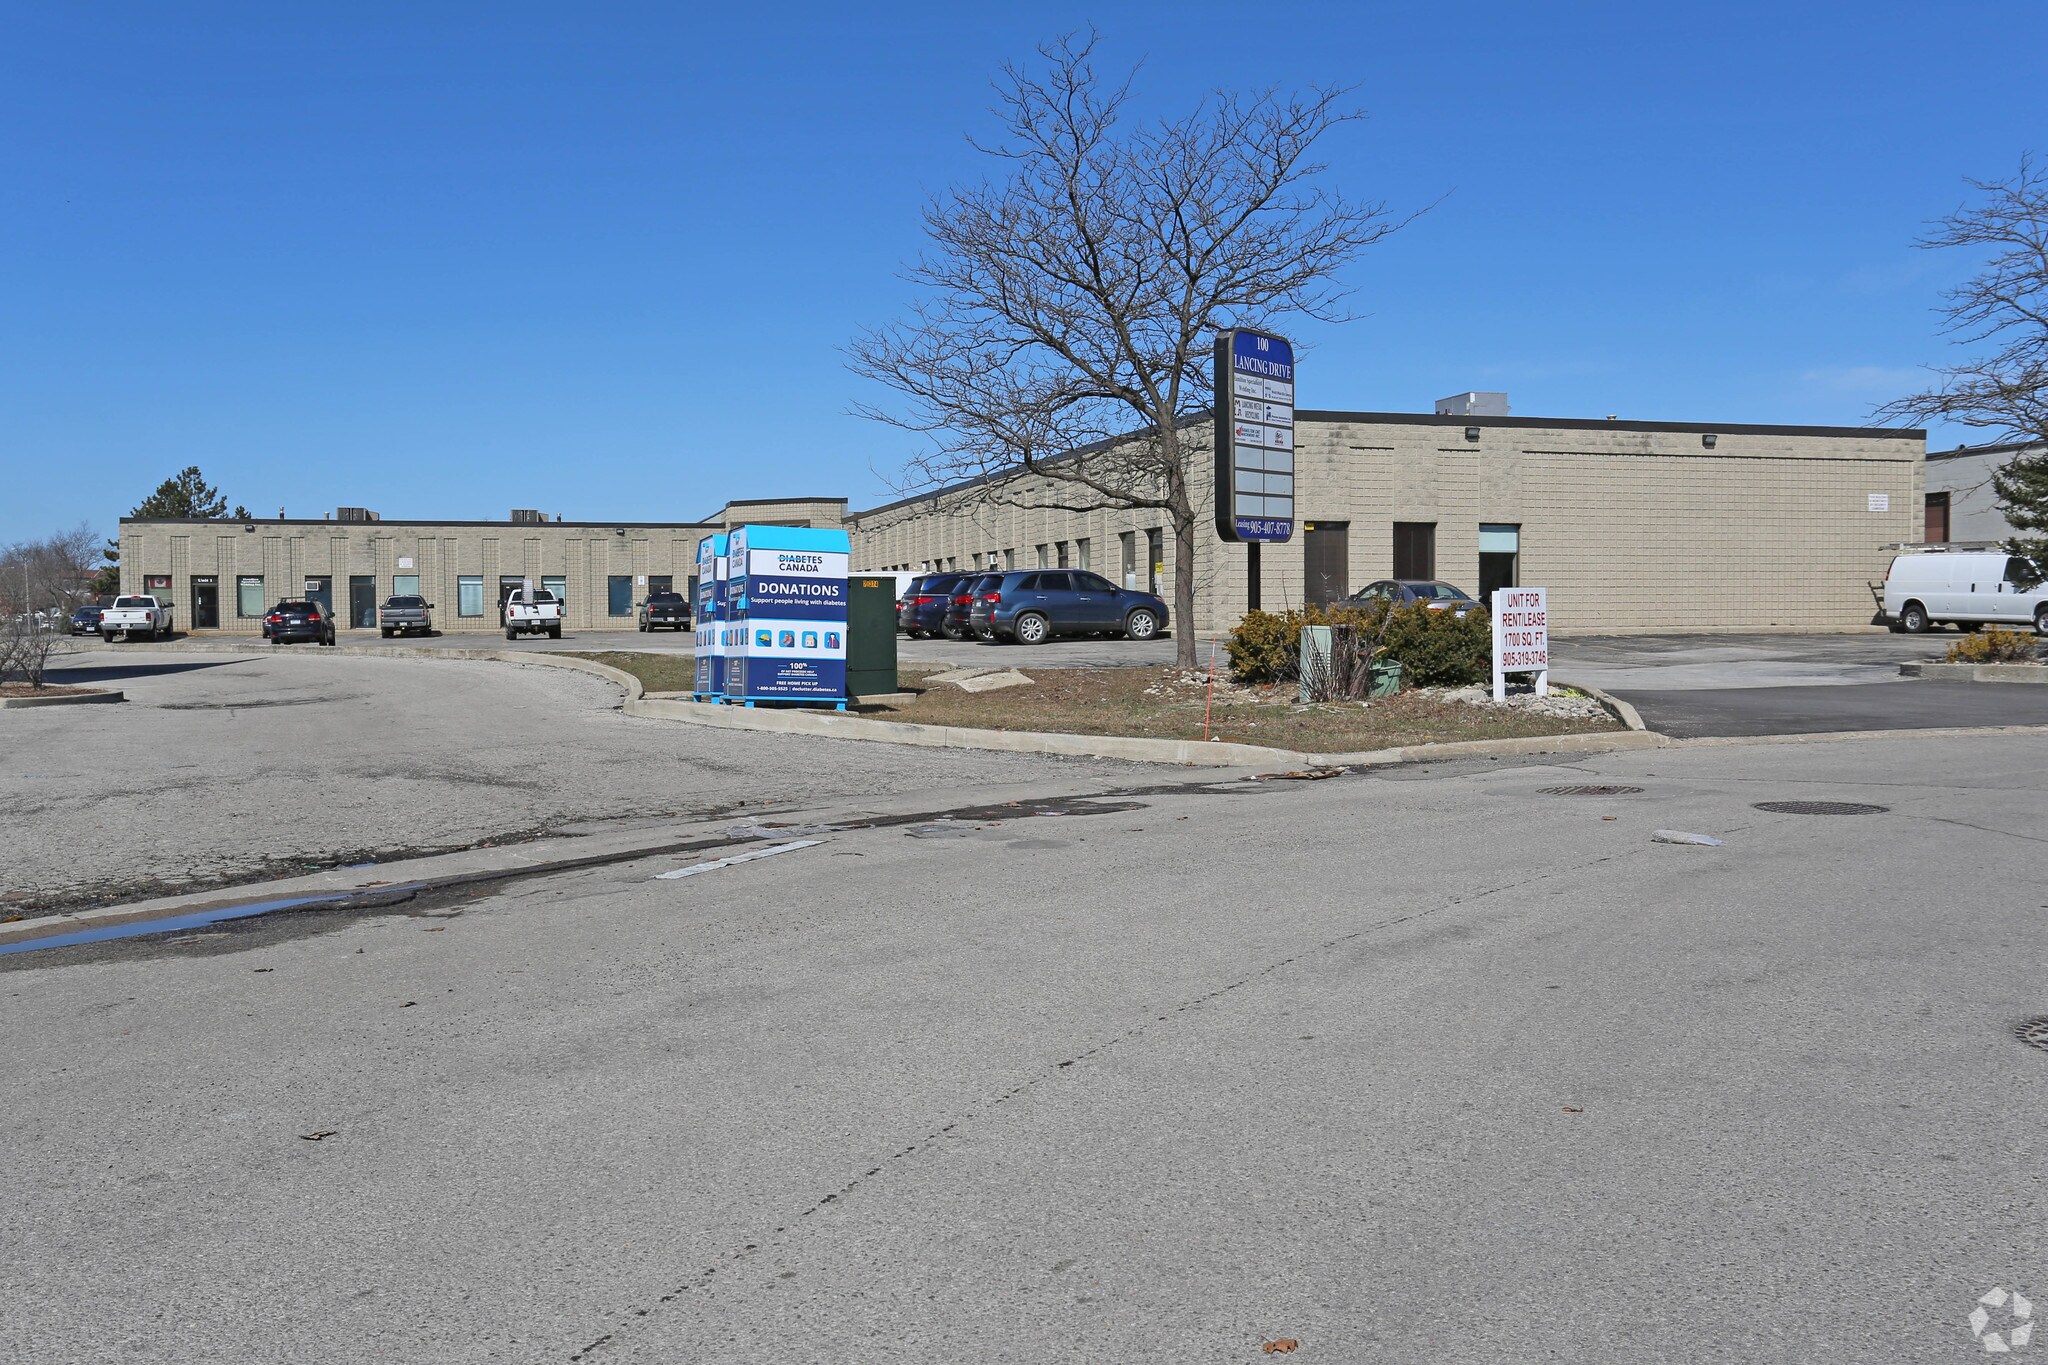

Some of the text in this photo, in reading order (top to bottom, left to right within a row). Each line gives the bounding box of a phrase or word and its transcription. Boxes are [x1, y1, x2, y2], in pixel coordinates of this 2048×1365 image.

[1257, 337, 1269, 351] 100
[1234, 353, 1292, 379] LANCING DRIVE
[1235, 519, 1250, 530] Leasing
[1250, 520, 1291, 535] 905-407-8778
[778, 554, 823, 564] DIABETES
[779, 563, 819, 573] CANADA
[759, 582, 839, 597] DONATIONS
[794, 598, 809, 606] living
[1507, 593, 1540, 608] UNIT FOR
[1502, 612, 1546, 627] RENT/LEASE
[1504, 631, 1545, 647] 1700 SQ. FT.
[790, 662, 807, 670] 100%
[1502, 650, 1547, 667] 905-319-3746
